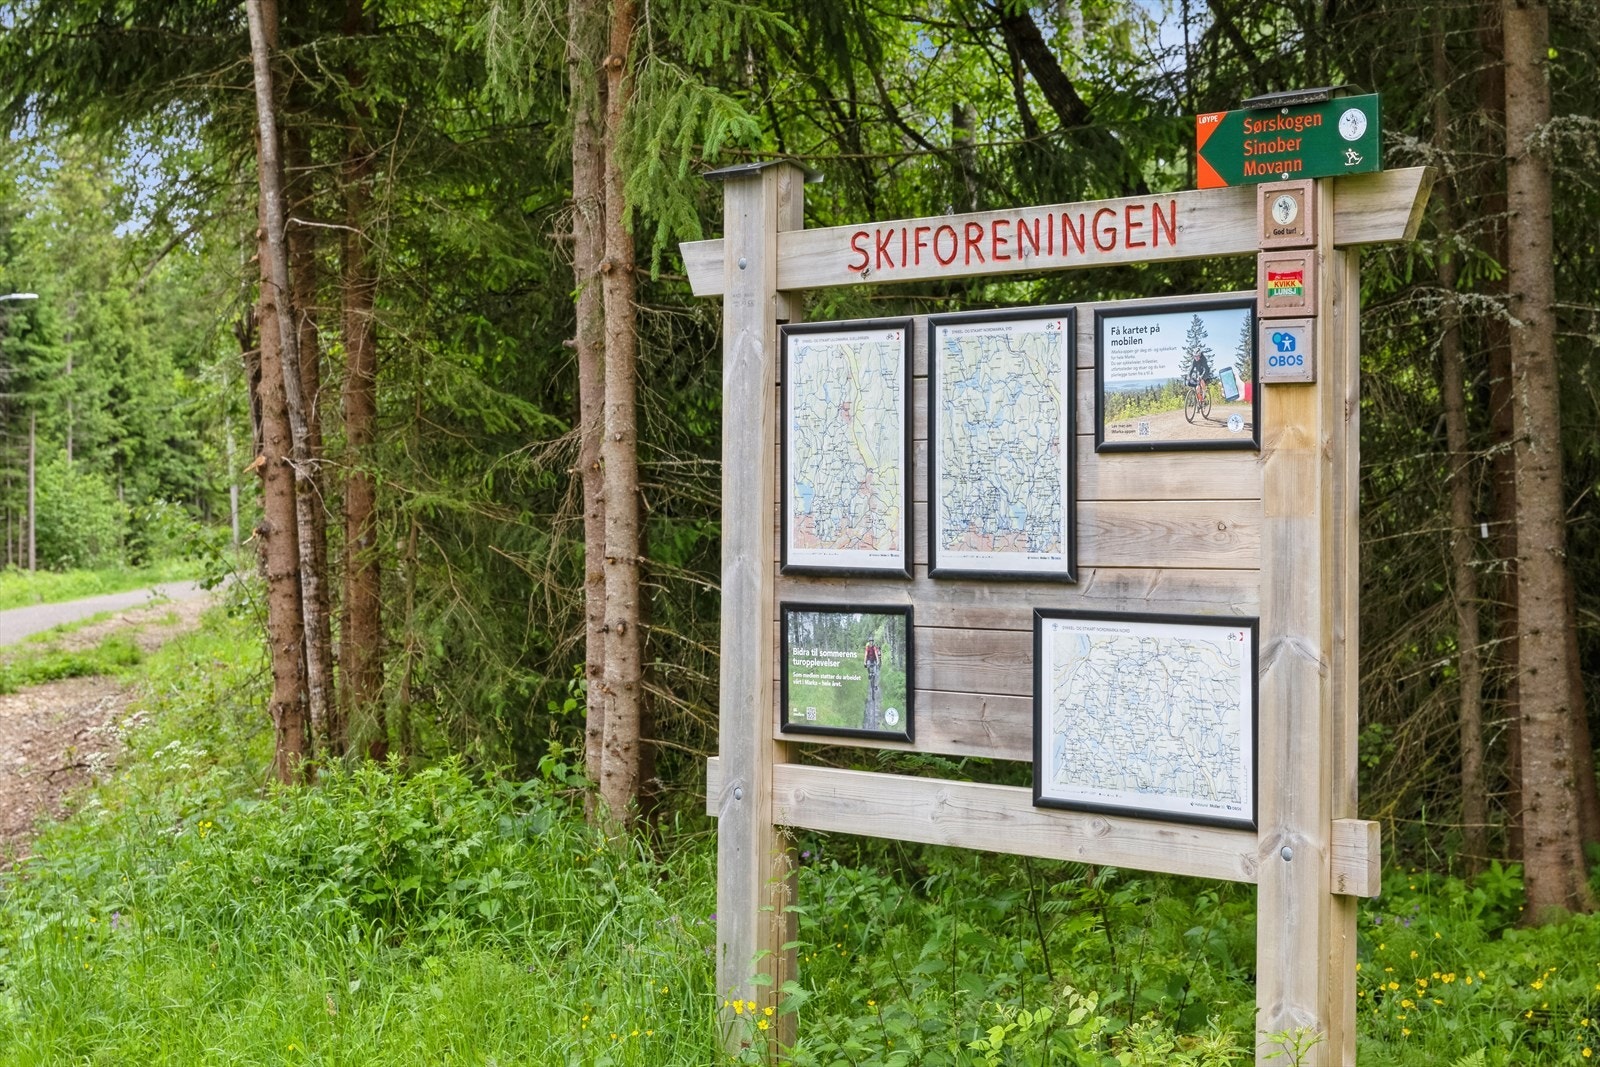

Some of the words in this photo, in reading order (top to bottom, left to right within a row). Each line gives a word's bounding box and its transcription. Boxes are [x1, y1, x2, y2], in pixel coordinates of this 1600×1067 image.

[1198, 114, 1219, 125] LØYPE
[1243, 113, 1322, 135] Sørskogen
[1243, 136, 1303, 156] Sinober
[1243, 158, 1303, 177] Movann
[847, 199, 1177, 272] SKIFORENINGEN
[1273, 228, 1285, 236] God
[1273, 280, 1296, 288] KVIKK
[1273, 287, 1297, 296] LUNSJ
[1111, 326, 1120, 336] Få
[1122, 325, 1147, 334] kartet
[1149, 323, 1160, 334] på
[1111, 336, 1142, 346] mobilen
[1268, 354, 1304, 367] OBOS
[793, 647, 809, 656] Bidra
[793, 657, 840, 668] turopplevelser
